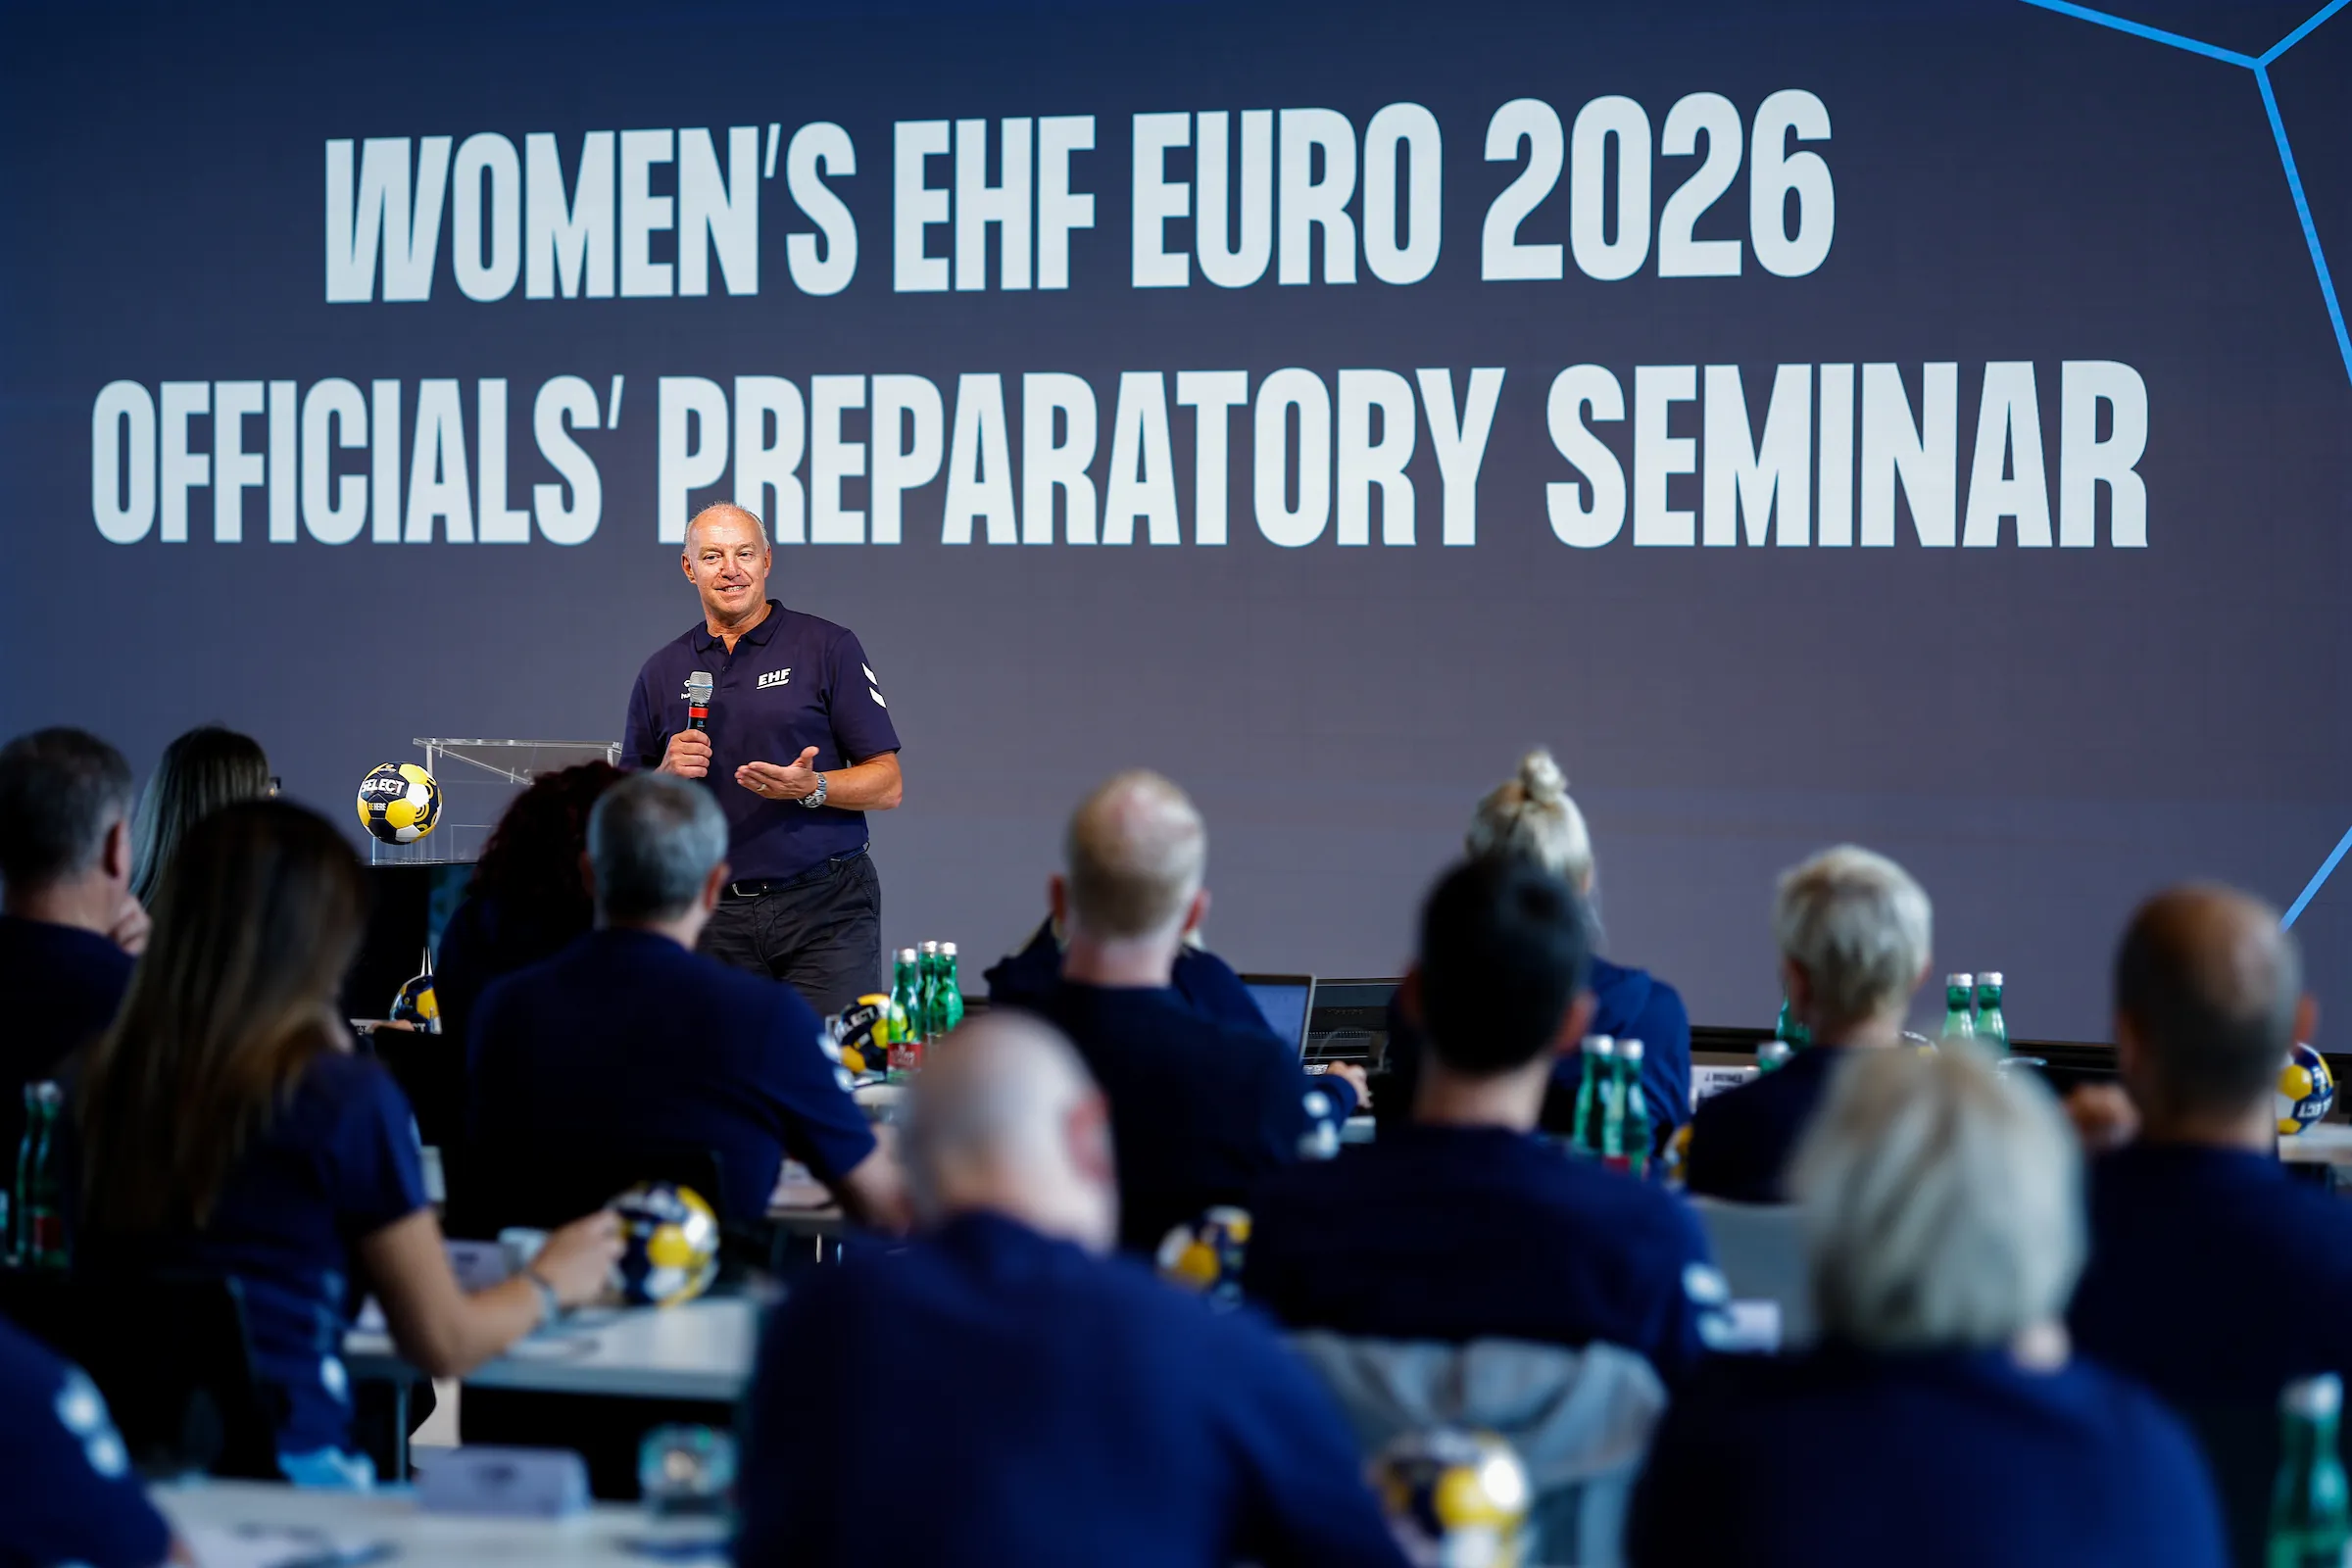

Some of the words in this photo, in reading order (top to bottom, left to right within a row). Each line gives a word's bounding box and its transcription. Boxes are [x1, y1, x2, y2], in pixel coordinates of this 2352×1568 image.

[325, 122, 857, 302] WOMEN'S
[894, 115, 1096, 291] EHF
[1131, 103, 1443, 288] EURO
[1482, 89, 1836, 281] 2026
[92, 375, 624, 545] OFFICIALS'
[658, 368, 1505, 547] PREPARATORY
[1545, 361, 2149, 549] SEMINAR
[759, 667, 792, 686] EHF
[361, 778, 405, 795] SELECT
[373, 802, 387, 811] HERE
